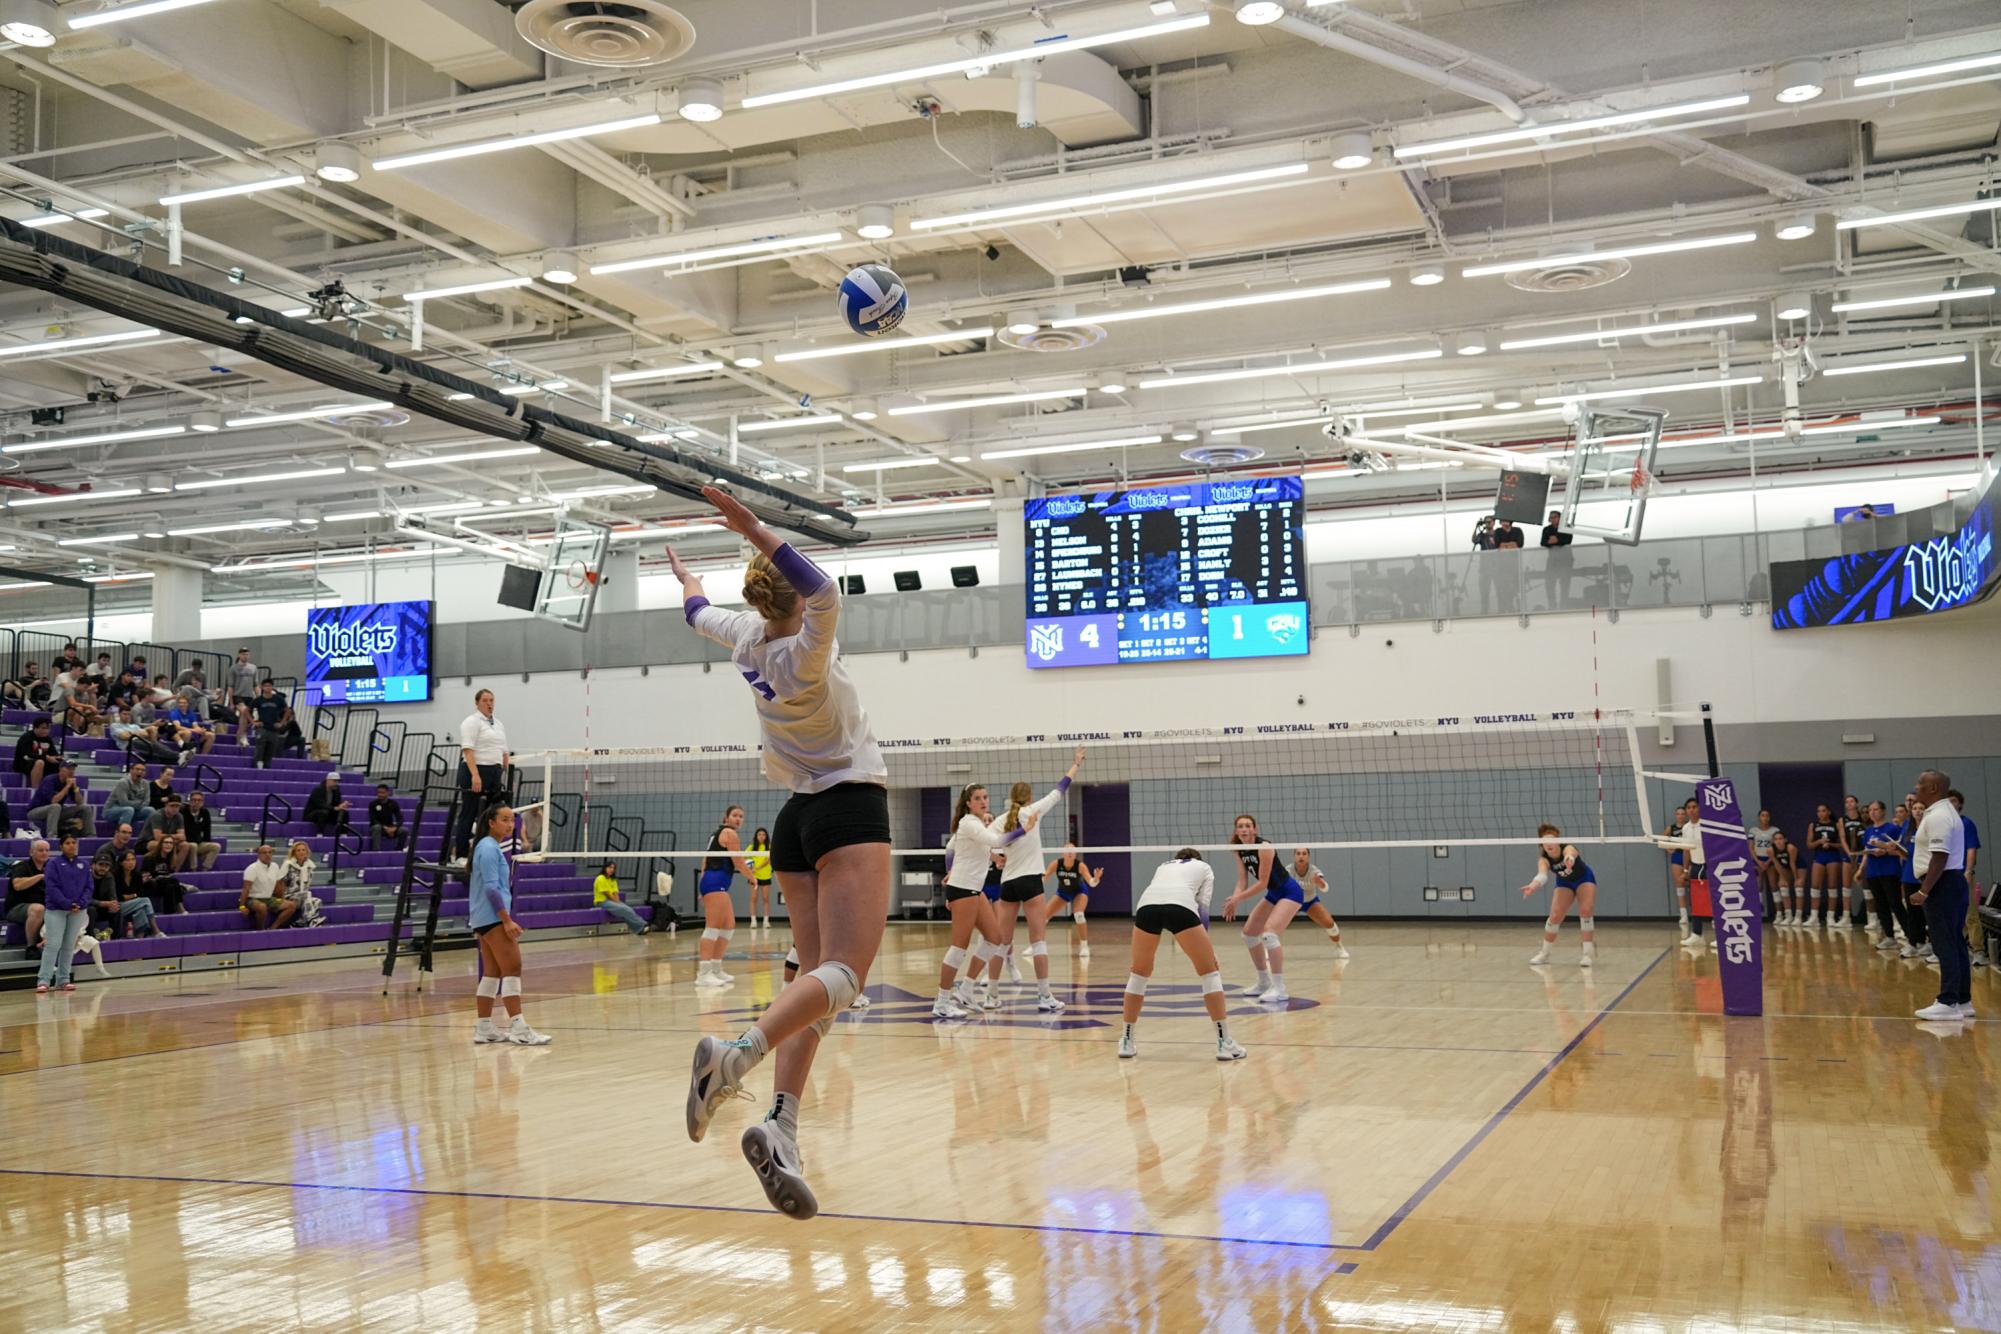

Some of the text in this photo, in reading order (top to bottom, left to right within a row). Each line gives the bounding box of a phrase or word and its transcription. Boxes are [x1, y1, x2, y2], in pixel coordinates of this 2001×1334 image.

[1204, 502, 1251, 514] NEWPORT
[1030, 519, 1050, 528] NYU
[1110, 522, 1118, 531] 4
[1180, 516, 1188, 526] 3
[1180, 527, 1188, 537] 7
[1260, 521, 1268, 531] 7
[1284, 519, 1290, 529] 1
[1051, 536, 1087, 547] NELSON
[1132, 532, 1140, 541] 4
[1197, 536, 1232, 547] ADAMS
[1133, 542, 1139, 552] 1
[1197, 547, 1229, 558] CROFT
[1051, 558, 1089, 569] BARTON
[1133, 554, 1139, 564] 1
[1111, 567, 1119, 576] 0
[1132, 565, 1140, 575] 7
[1284, 566, 1293, 576] 4
[1134, 576, 1140, 586] 1
[1139, 611, 1186, 632] 1:15
[1232, 614, 1244, 640] 1
[308, 620, 397, 659] Violets
[1080, 624, 1099, 648] 4
[1201, 635, 1208, 644] 4
[329, 655, 375, 668] VOLLEYBALL
[354, 678, 376, 688] 1:15
[402, 680, 409, 693] 1
[933, 737, 951, 746] NYU
[1026, 734, 1045, 743] NYU
[1057, 731, 1111, 742] VOLLEYBALL
[1123, 730, 1142, 739] NYU
[1223, 726, 1244, 735] NYU
[1257, 723, 1315, 734] VOLLEYBALL
[1328, 721, 1349, 730] NYU
[1362, 718, 1425, 729] #GOVIOLETS
[1437, 717, 1459, 727] NYU
[1474, 713, 1537, 725] VOLLEYBALL
[1551, 711, 1575, 721] NYU
[594, 748, 610, 756] NYU
[674, 746, 690, 754] NYU
[700, 744, 747, 753] VOLLEYBALL
[1713, 856, 1755, 965] Violets
